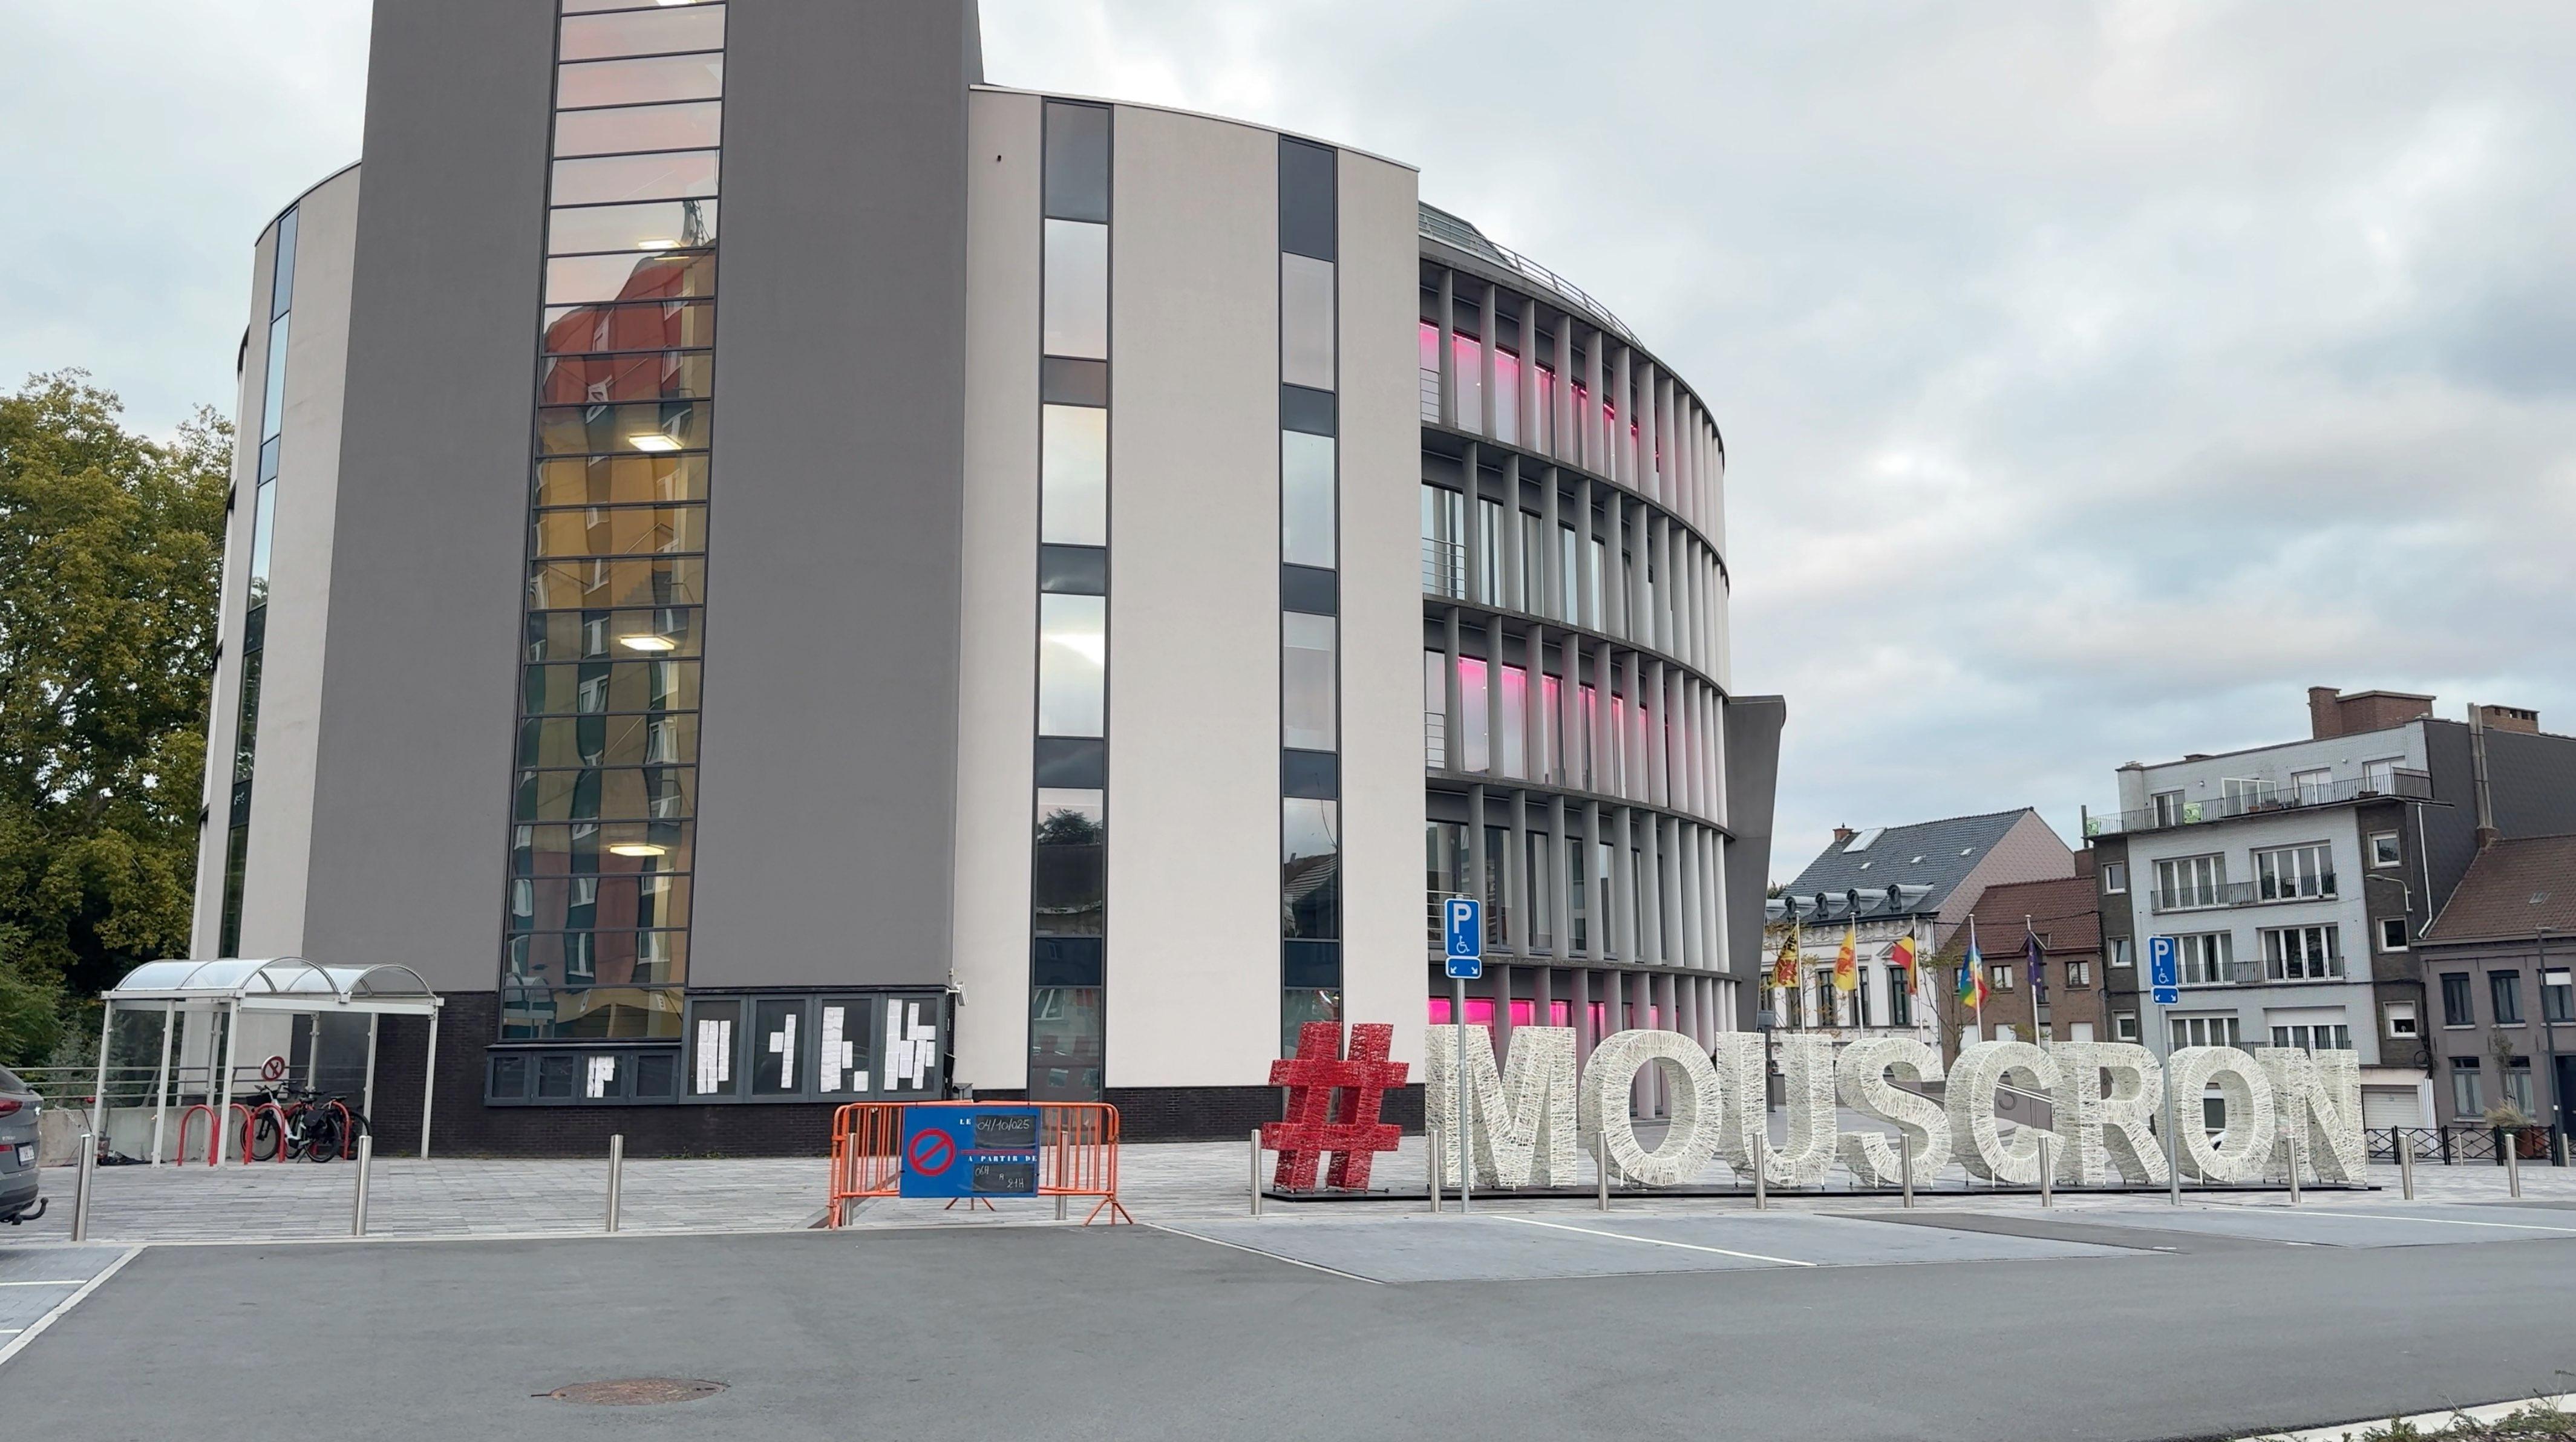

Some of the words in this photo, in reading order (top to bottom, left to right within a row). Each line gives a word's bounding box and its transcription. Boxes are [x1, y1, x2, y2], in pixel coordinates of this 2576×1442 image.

[1453, 903, 1472, 933] P
[2154, 940, 2169, 967] P
[1261, 1022, 2367, 1193] #MOUSCRON
[974, 1165, 990, 1176] 06H
[1006, 1178, 1024, 1189] 21H
